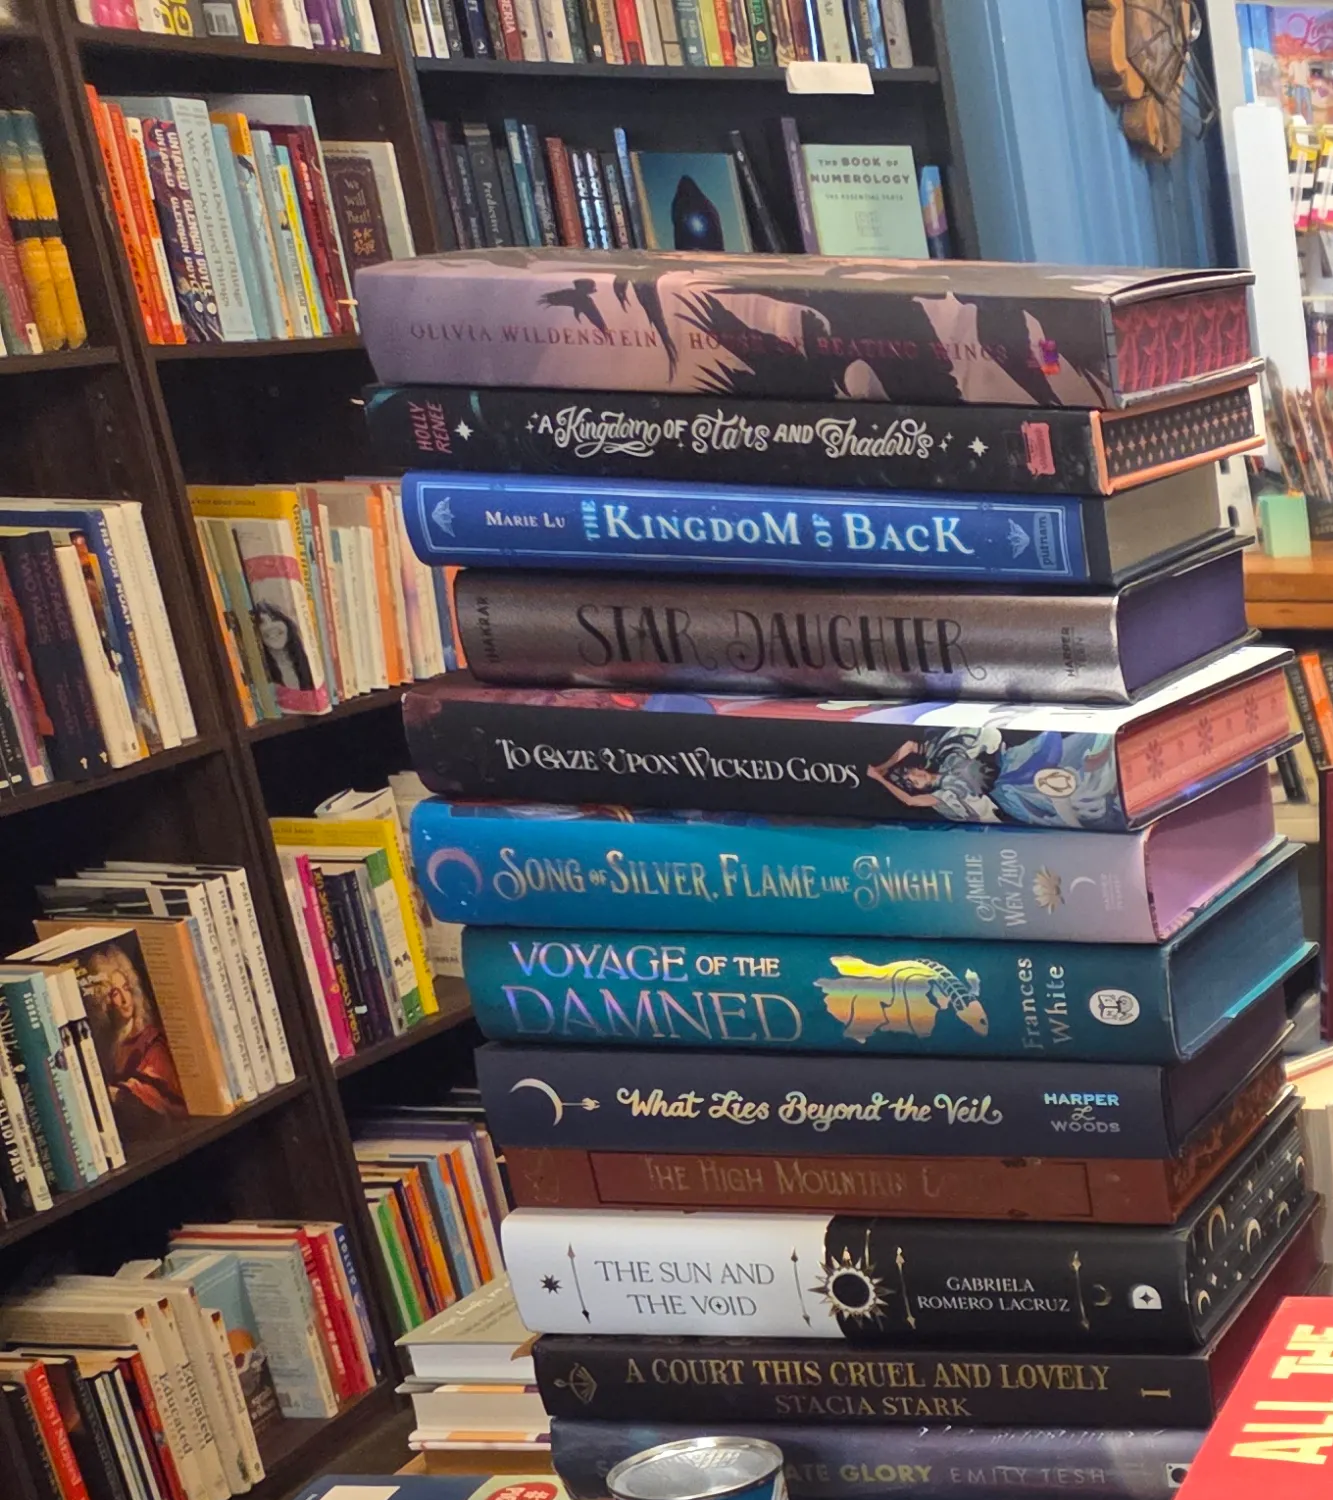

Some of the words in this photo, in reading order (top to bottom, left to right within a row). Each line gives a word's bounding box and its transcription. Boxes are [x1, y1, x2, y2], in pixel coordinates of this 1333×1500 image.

[166, 131, 190, 191] UNTAMED
[810, 173, 911, 184] NUMEROLOGY
[841, 156, 881, 167] BOOK
[410, 323, 493, 342] OLIVIA
[502, 326, 659, 349] WILDENSTEIN
[410, 401, 434, 452] HOLLY
[425, 401, 453, 454] RENEE
[537, 417, 554, 435] A
[663, 418, 687, 440] OF
[692, 408, 771, 454] Stars
[773, 422, 814, 445] AND
[815, 417, 934, 460] Shadows
[580, 499, 602, 542] THE
[603, 503, 801, 546] KINGDOM
[812, 513, 833, 552] OF
[843, 511, 976, 557] BACK
[1034, 514, 1051, 569] putnam
[575, 603, 714, 669] STAR
[727, 607, 988, 682] DAUGHTER
[495, 737, 531, 769] TO
[785, 757, 861, 789] GODS
[493, 847, 584, 902] SONG
[719, 853, 819, 899] FLAME
[821, 875, 851, 895] LIKE
[852, 854, 955, 910] NIGHT
[508, 940, 687, 983] VOYAGE
[695, 954, 728, 978] OF
[732, 954, 781, 978] THE
[500, 984, 803, 1044] DAMNED
[1022, 956, 1045, 1052] Frances
[1050, 962, 1071, 1047] White
[615, 1087, 704, 1120] What
[707, 1089, 770, 1123] Lies
[778, 1089, 890, 1132] Beyond
[886, 1093, 932, 1124] the
[932, 1093, 1004, 1125] Veil
[1043, 1092, 1121, 1107] HARPER
[1050, 1120, 1122, 1134] WOODS
[594, 1259, 657, 1284] THE
[660, 1261, 717, 1286] SUN
[720, 1262, 776, 1287] AND
[946, 1276, 1036, 1293] GABRIELA
[626, 1294, 688, 1316] THE
[694, 1294, 758, 1317] VOID
[917, 1295, 995, 1311] ROMERO
[998, 1296, 1071, 1313] LACRUZ
[624, 1358, 646, 1385] A
[651, 1358, 745, 1386] COURT
[752, 1360, 823, 1387] THIS
[830, 1361, 927, 1389] CRUEL
[933, 1362, 993, 1390] AND
[1000, 1363, 1111, 1391] LOVELY
[775, 1395, 874, 1417] STACIA
[881, 1396, 972, 1418] STARK
[840, 1462, 933, 1484] GLORY
[950, 1465, 1032, 1485] EMILY
[1040, 1467, 1107, 1486] TESH
